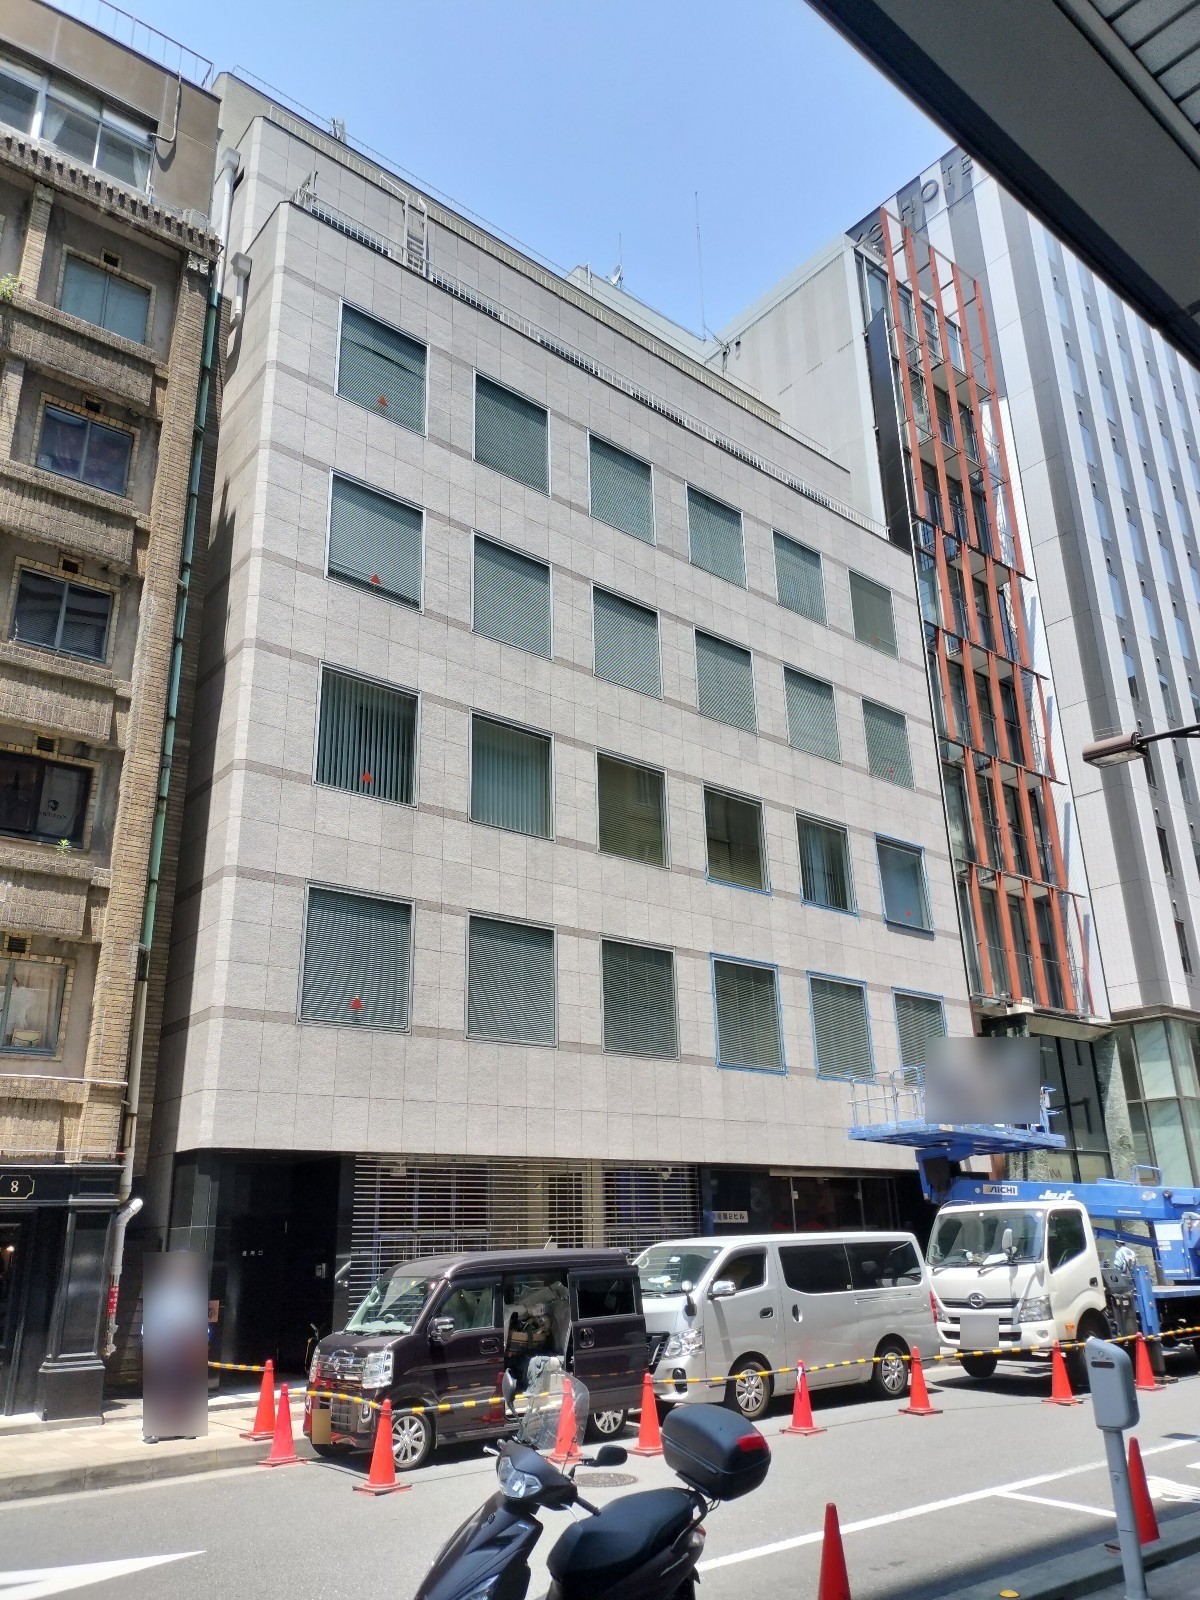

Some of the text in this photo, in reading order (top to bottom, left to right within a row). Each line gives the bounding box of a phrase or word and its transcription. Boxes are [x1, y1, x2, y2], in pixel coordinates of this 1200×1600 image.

[10, 1180, 19, 1193] 8
[987, 1185, 1016, 1195] AICHI
[1039, 1189, 1075, 1200] Just
